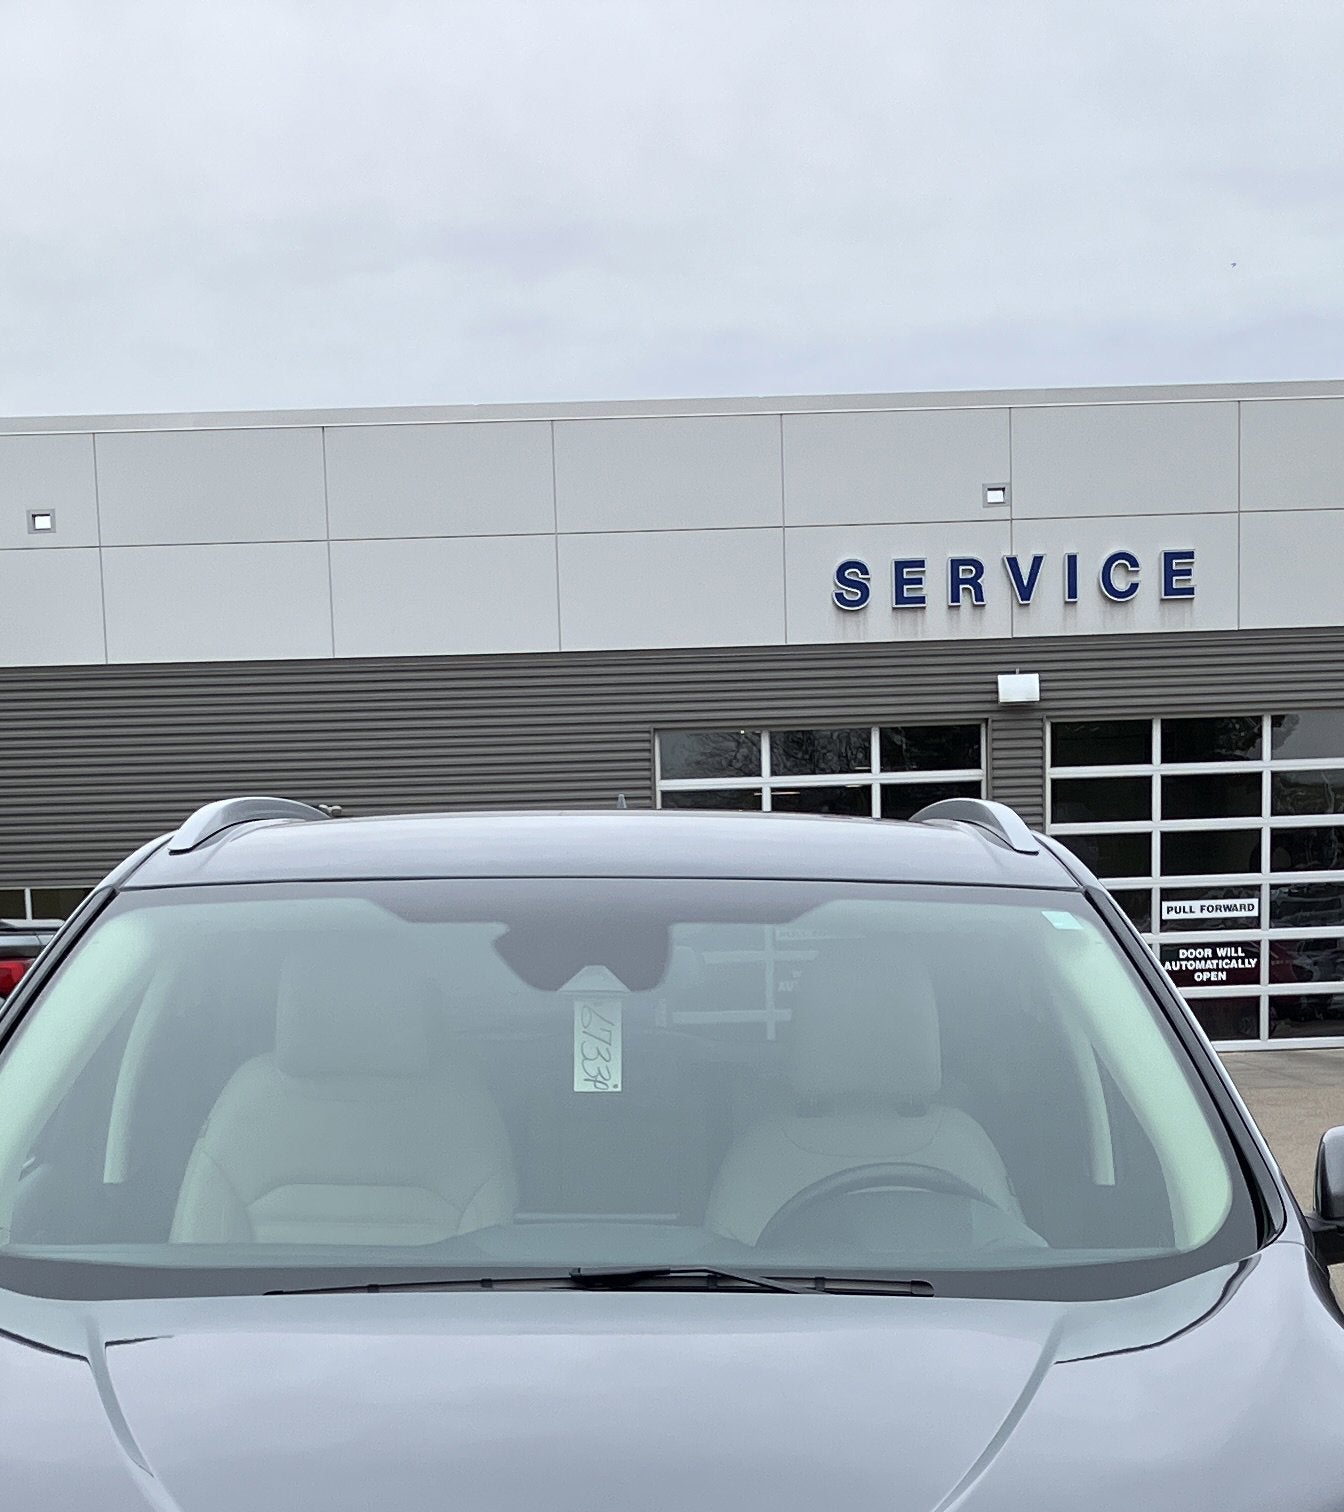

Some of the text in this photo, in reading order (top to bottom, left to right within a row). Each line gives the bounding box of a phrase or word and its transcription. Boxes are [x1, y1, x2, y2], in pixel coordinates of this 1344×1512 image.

[832, 549, 1196, 611] SERVICE
[1166, 903, 1255, 915] PULL FORWARD
[1178, 946, 1246, 959] DOOR WILL
[1164, 958, 1258, 971] AUTOMATICALLY
[1193, 970, 1227, 982] OPEN
